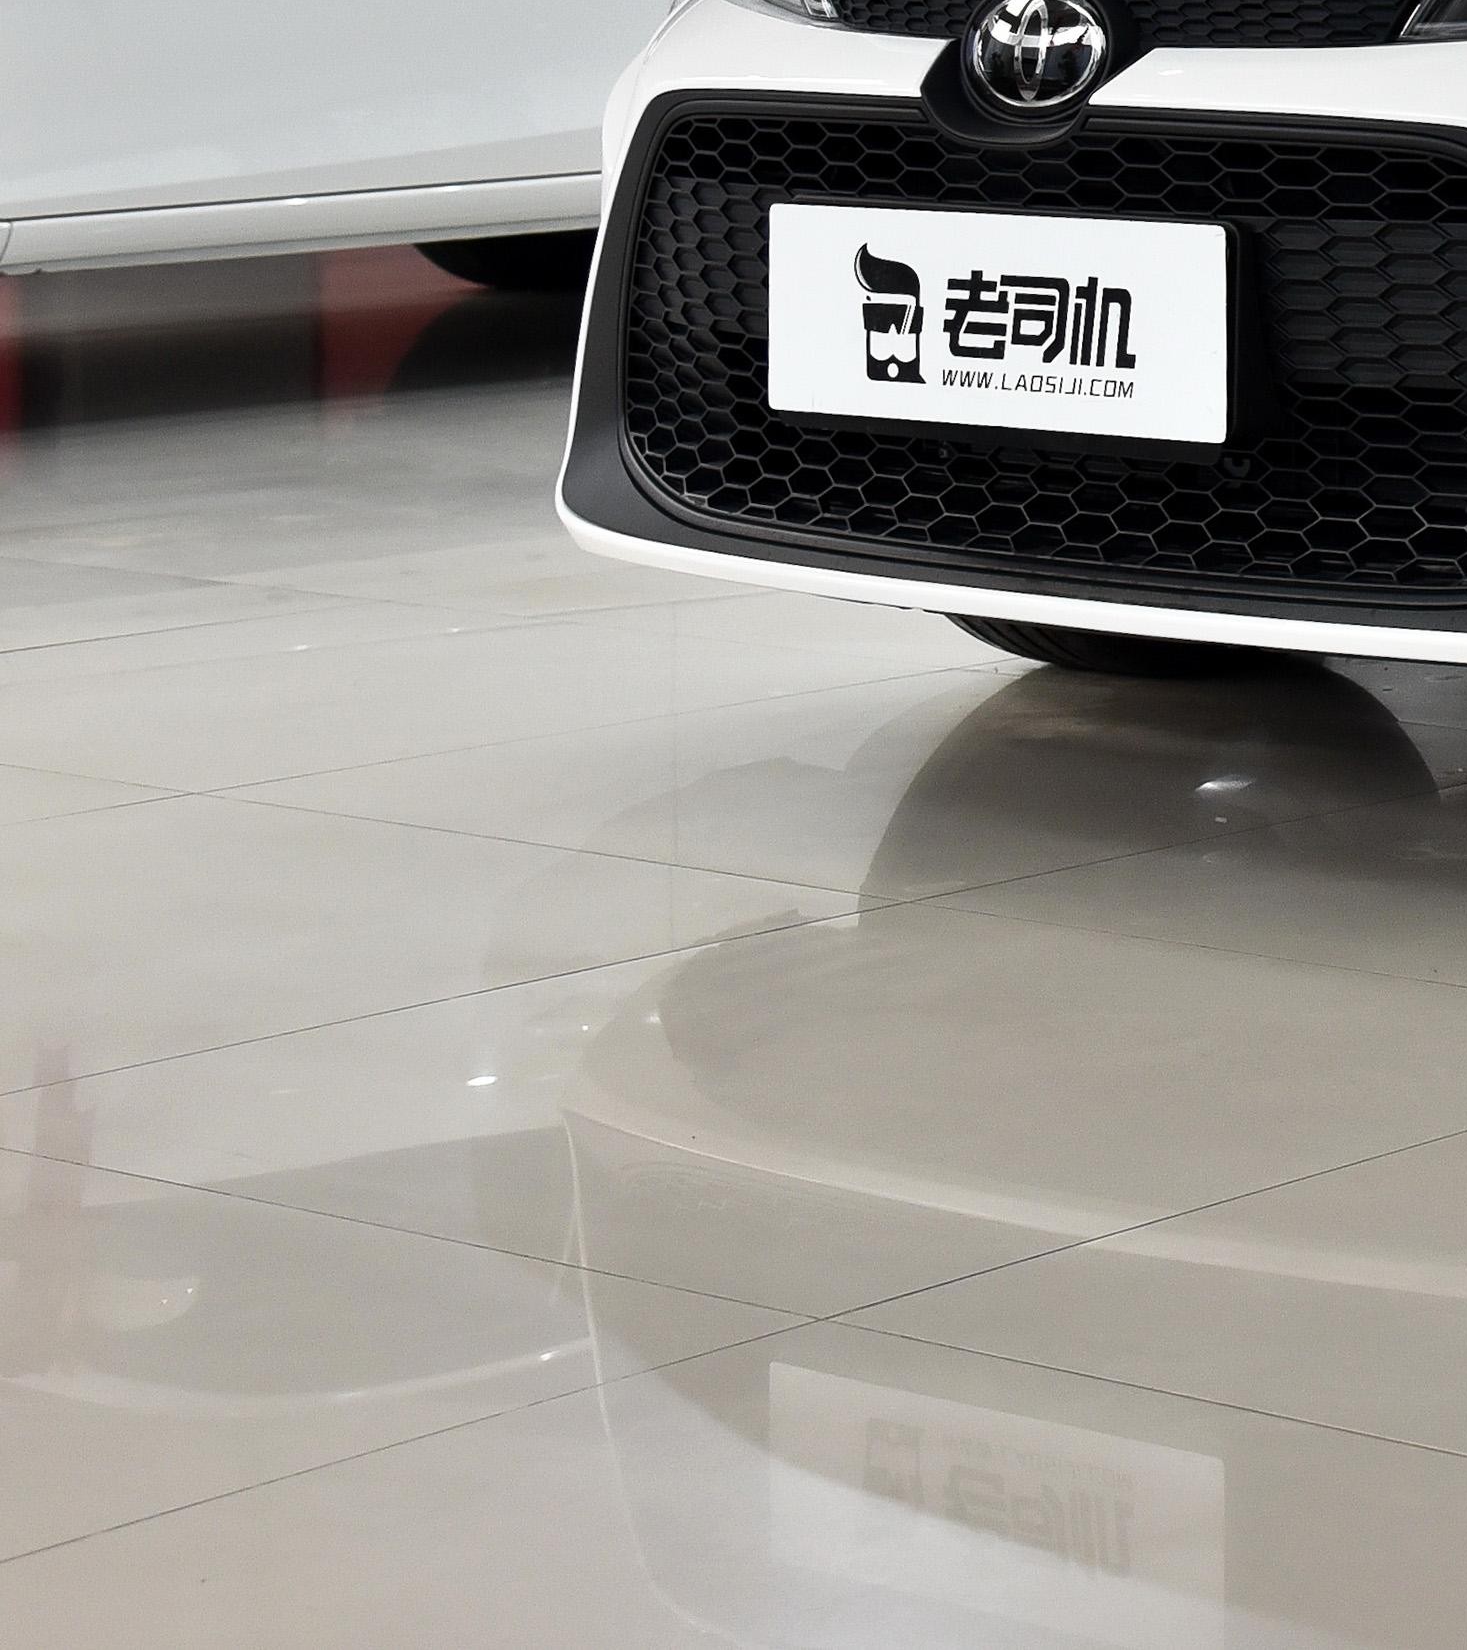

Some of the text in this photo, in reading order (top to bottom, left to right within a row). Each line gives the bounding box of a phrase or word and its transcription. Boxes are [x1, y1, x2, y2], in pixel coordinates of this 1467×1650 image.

[942, 269, 1137, 369] 老司机
[941, 368, 1135, 399] WWW.LAOSIJI.COM
